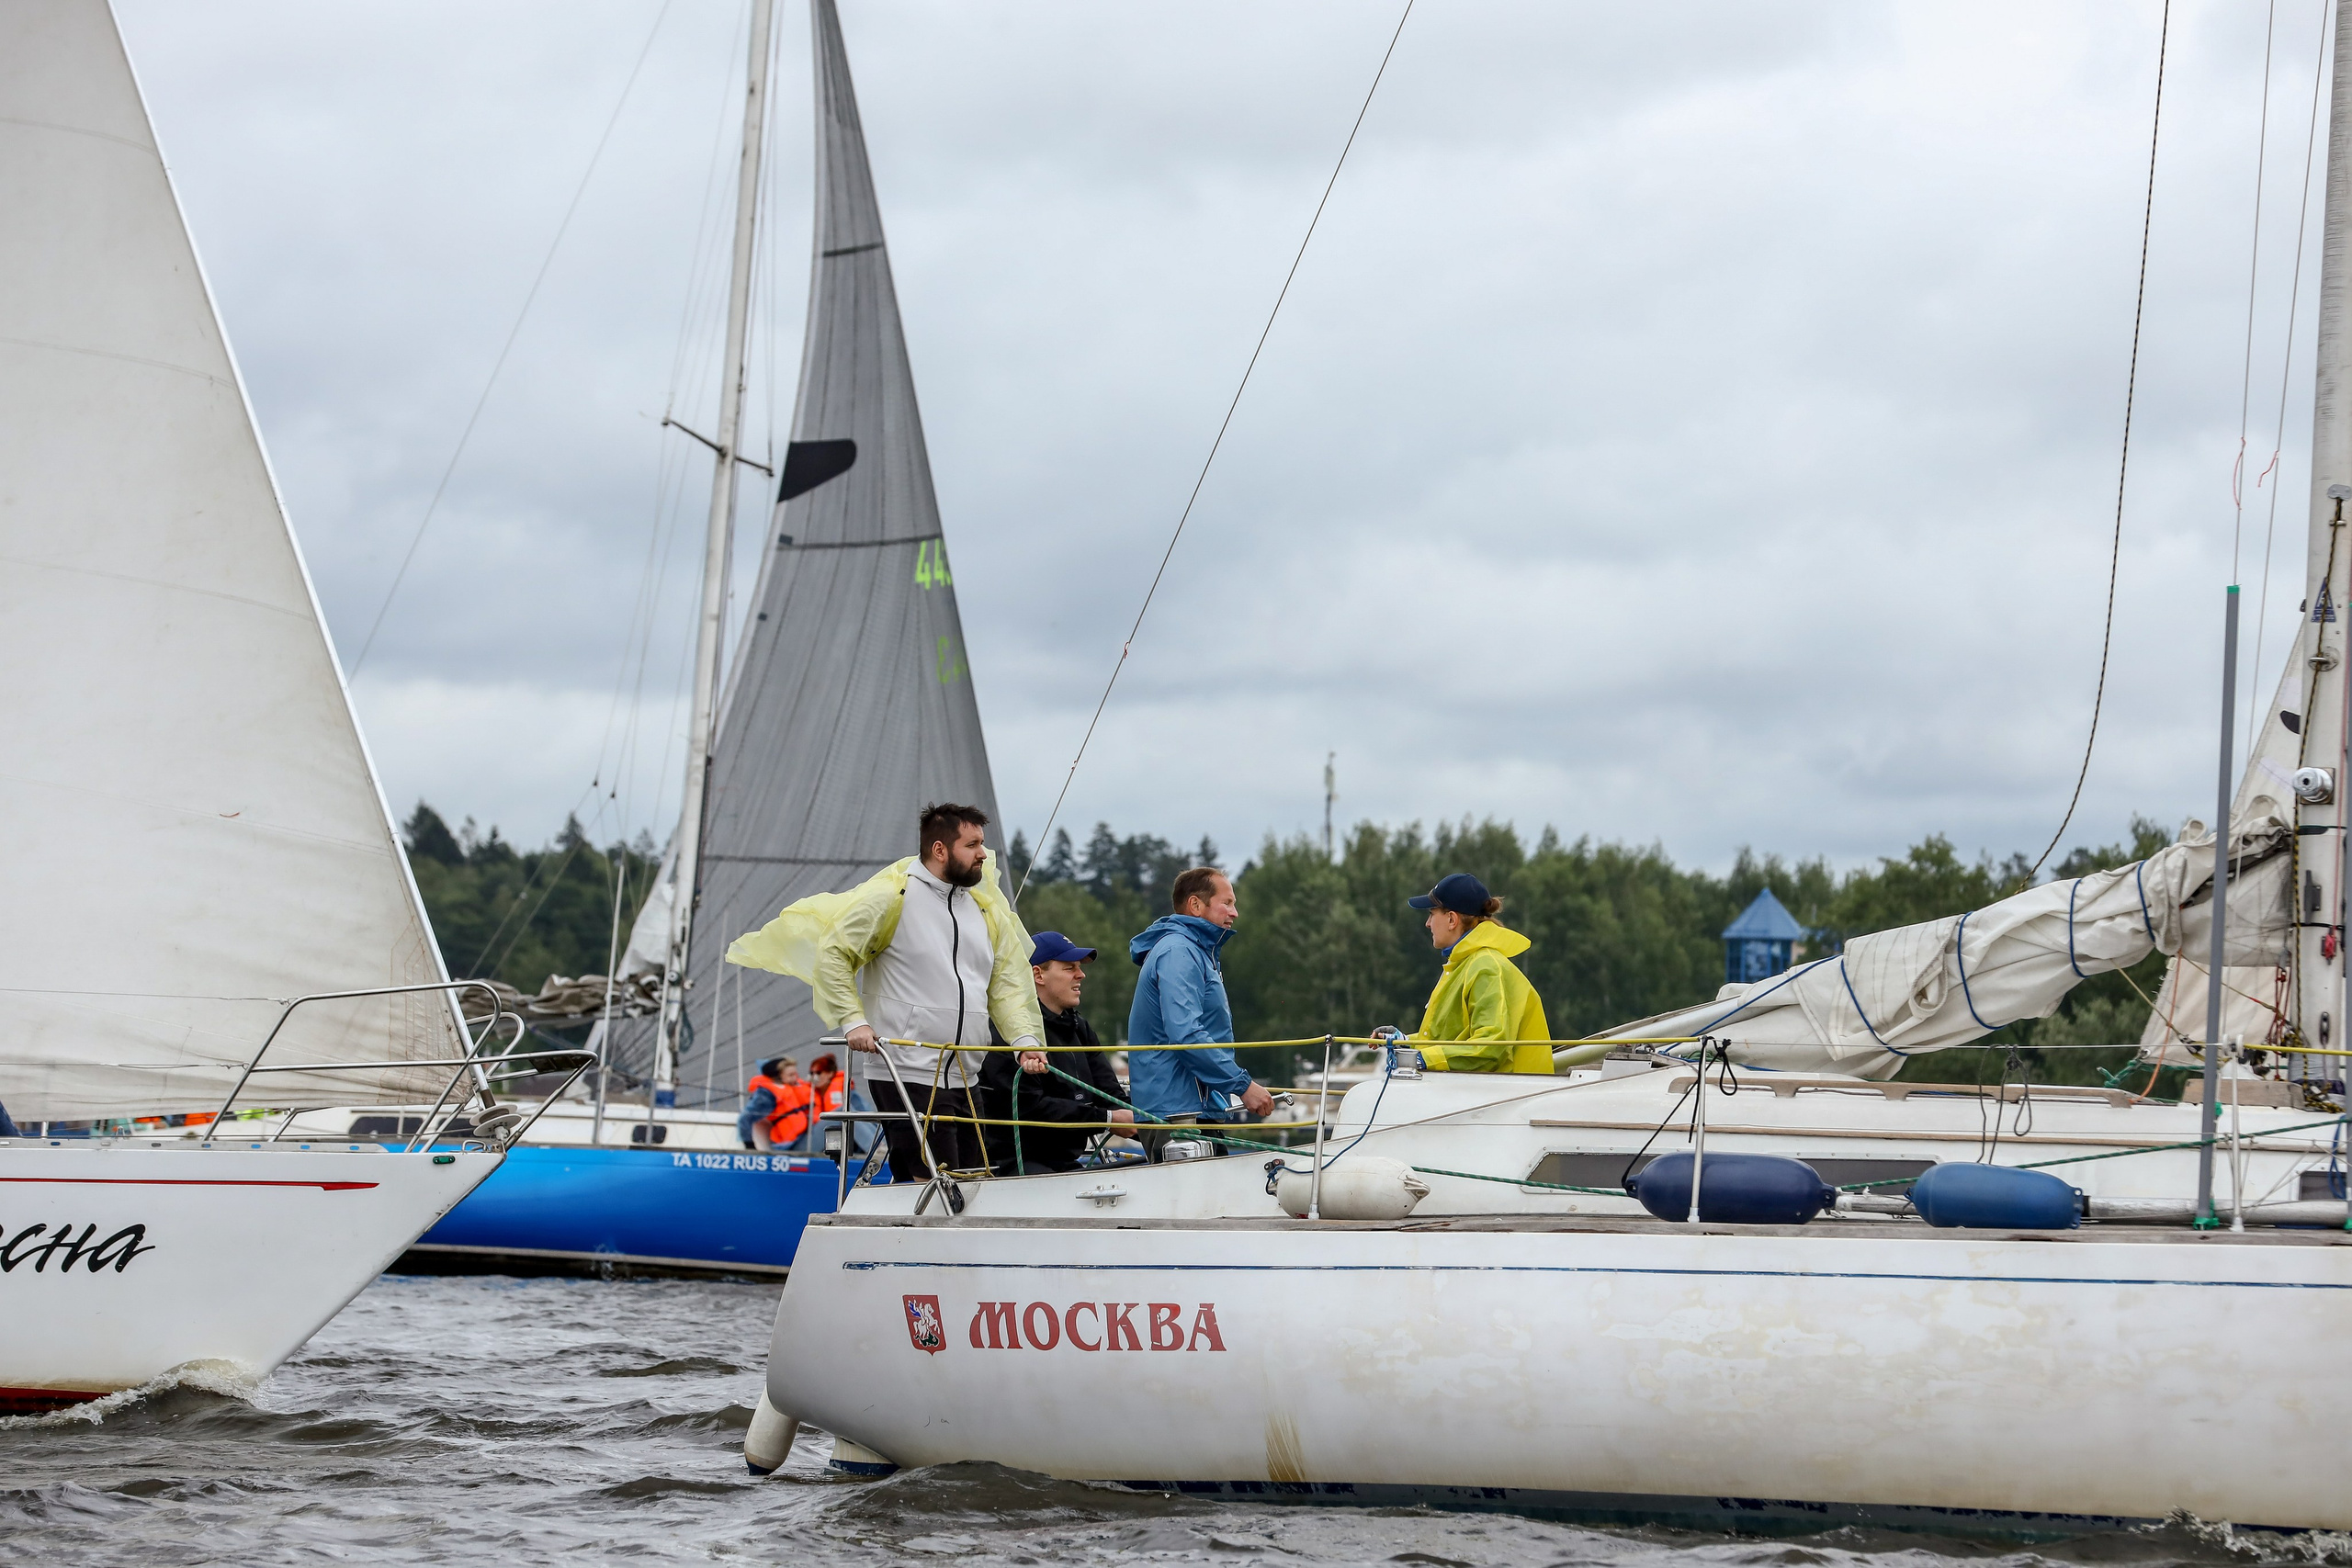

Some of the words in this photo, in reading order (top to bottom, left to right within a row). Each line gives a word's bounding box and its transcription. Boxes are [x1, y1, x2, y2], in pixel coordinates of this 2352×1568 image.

[672, 1152, 692, 1168] TA
[695, 1154, 730, 1169] 1022
[733, 1155, 768, 1171] RUS
[771, 1156, 790, 1172] 50
[0, 1223, 156, 1273] сна
[968, 1301, 1227, 1352] МОСКВА
